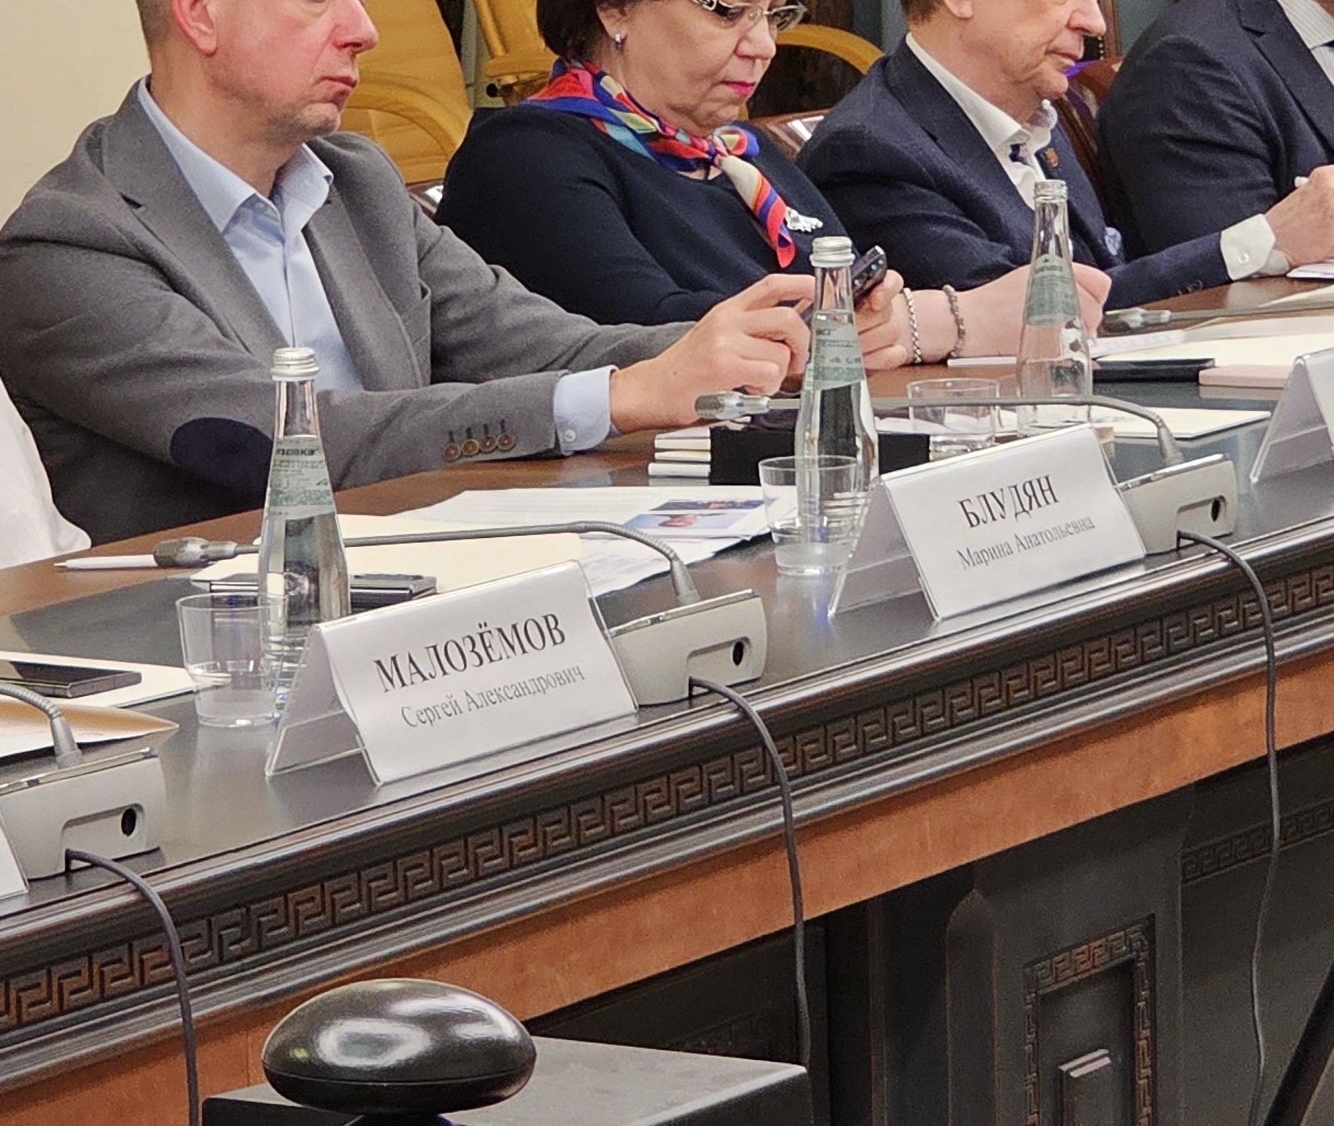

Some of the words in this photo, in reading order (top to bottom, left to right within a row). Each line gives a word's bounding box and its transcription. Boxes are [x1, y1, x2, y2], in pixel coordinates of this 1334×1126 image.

[957, 474, 1060, 528] БЛУДЯН
[955, 540, 1014, 570] Марина
[1014, 515, 1096, 551] Анатольевна
[373, 613, 567, 693] МАЛОЗЁМОВ
[400, 693, 463, 728] Сергей
[465, 665, 586, 712] Александрович
